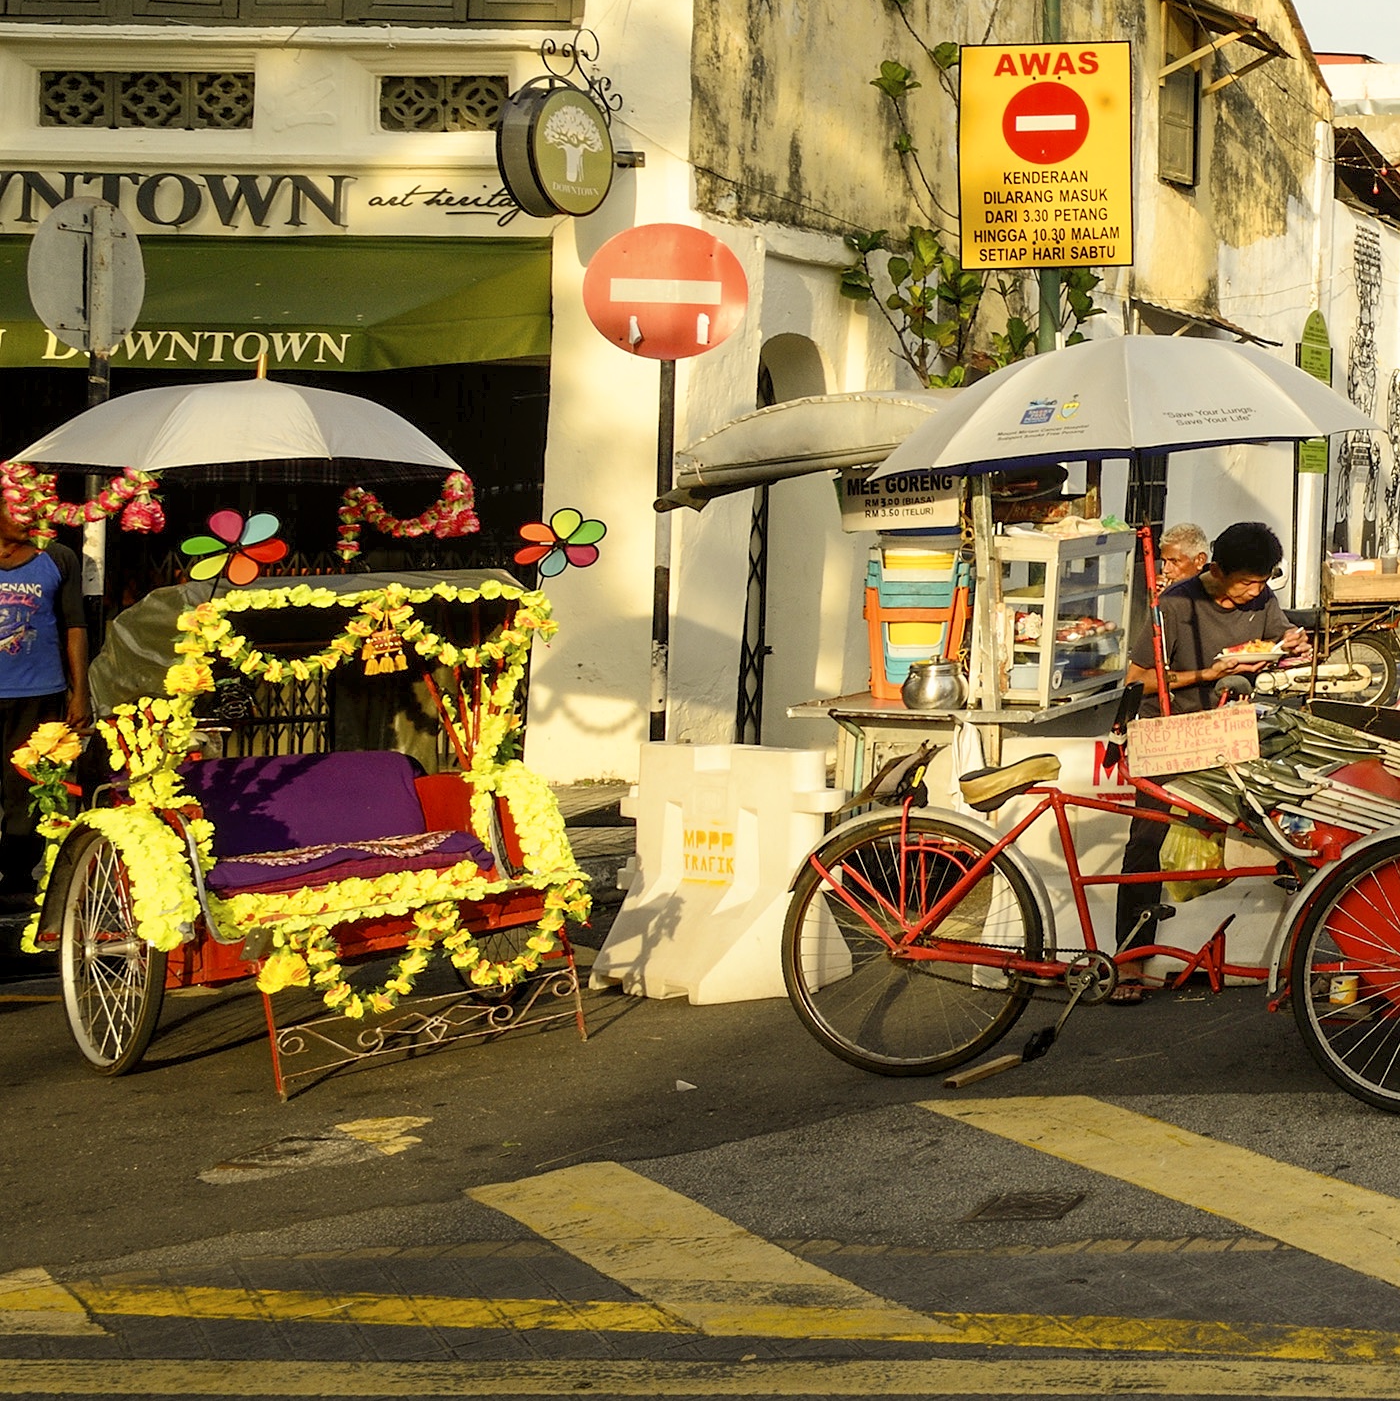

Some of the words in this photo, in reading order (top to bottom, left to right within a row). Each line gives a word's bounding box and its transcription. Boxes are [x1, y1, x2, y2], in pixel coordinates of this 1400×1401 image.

[994, 51, 1099, 76] AWAS
[1003, 170, 1088, 185] KENDERAAN
[0, 171, 357, 229] NTOWN
[368, 185, 414, 208] art
[983, 189, 1054, 204] DILARANG
[1059, 188, 1108, 202] MASUK
[985, 209, 1018, 224] DARI
[1023, 209, 1048, 222] 3.30
[1054, 207, 1108, 222] PETANG
[974, 228, 1028, 244] HINGGA
[1033, 228, 1066, 243] 10.30
[1071, 226, 1120, 241] MALAM
[979, 248, 1027, 262] SETIAP
[1032, 246, 1065, 260] HARI
[1070, 245, 1116, 259] SABTU
[41, 330, 352, 365] DWNTOWN
[1204, 416, 1228, 424] Your
[847, 478, 880, 496] MEE
[886, 475, 953, 494] GORENG
[864, 499, 879, 508] RM
[902, 496, 935, 506] (BIASA)
[865, 509, 879, 518] RM
[881, 509, 900, 517] 3.50
[902, 507, 934, 517] (TELUR)
[1130, 731, 1171, 747] FIXED
[1177, 725, 1211, 740] PRICE
[684, 829, 734, 852] MPPP
